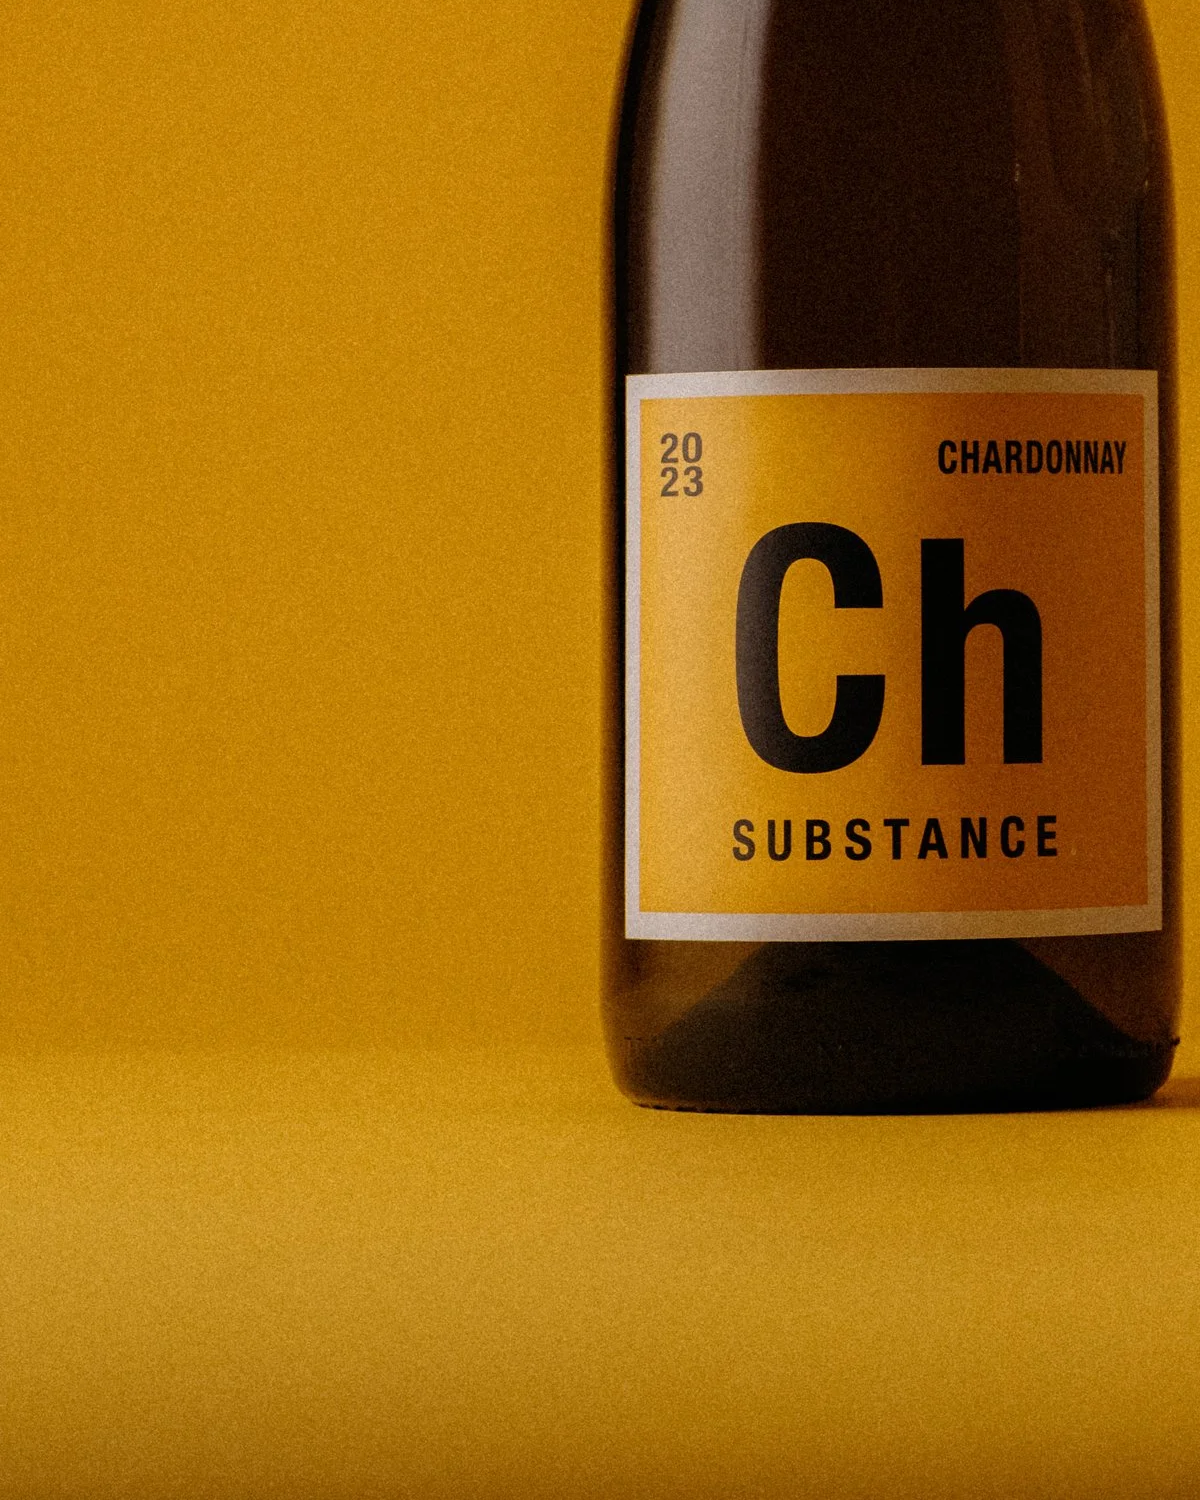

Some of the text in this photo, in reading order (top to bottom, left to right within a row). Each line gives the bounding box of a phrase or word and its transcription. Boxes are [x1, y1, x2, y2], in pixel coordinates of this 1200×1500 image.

[661, 433, 703, 463] 20
[937, 439, 1127, 476] CHARDONNAY
[661, 467, 704, 497] 23
[735, 522, 1043, 774] Ch
[732, 815, 1058, 862] SUBSTANCE
